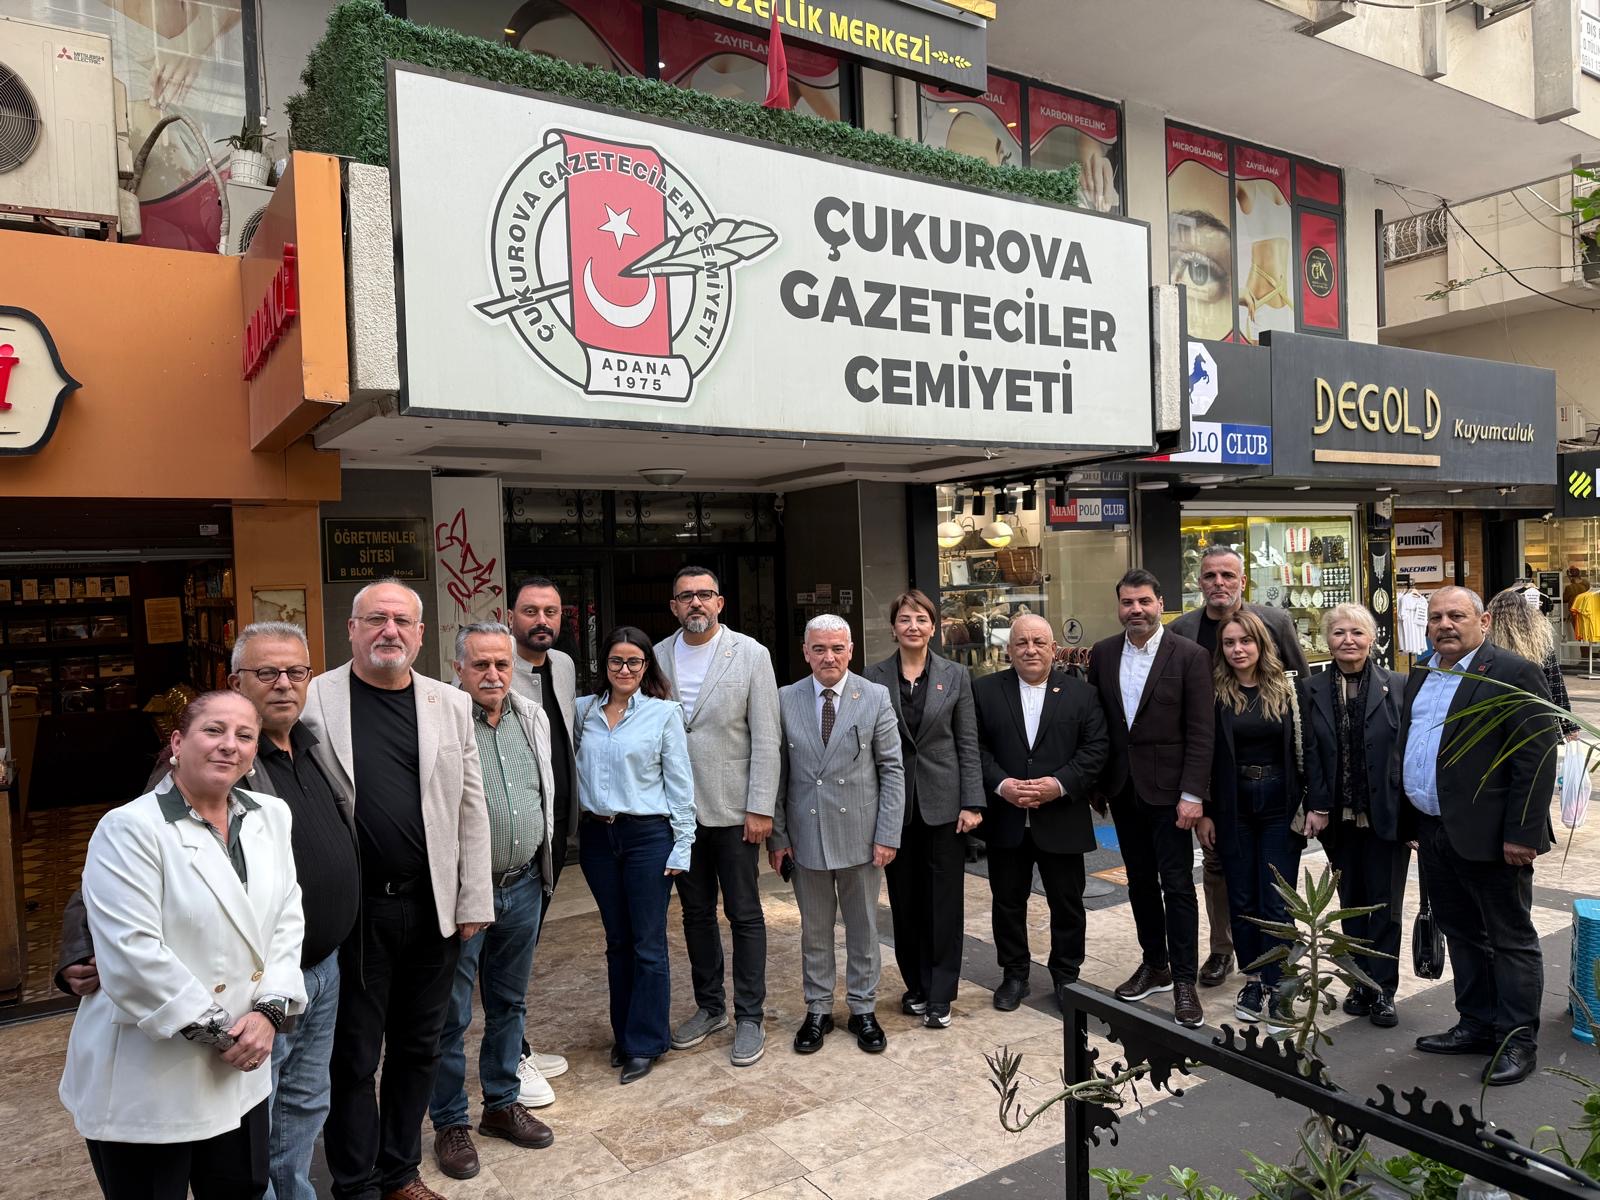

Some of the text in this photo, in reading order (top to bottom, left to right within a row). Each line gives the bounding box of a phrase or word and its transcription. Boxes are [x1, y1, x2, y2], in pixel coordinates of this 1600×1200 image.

[829, 11, 931, 65] MERKEZİ
[1040, 106, 1106, 131] KARBON PEELING
[1172, 140, 1223, 161] MICROBLADING
[1245, 160, 1279, 177] ZAYIFLAMA
[813, 195, 1093, 285] ÇUKUROVA
[507, 150, 725, 351] ÇUKUROVA GAZETECİLER CEMİYETİ
[779, 269, 1118, 353] GAZETECİLER
[601, 357, 672, 377] ADANA
[613, 374, 663, 392] 1975
[844, 349, 1074, 415] CEMİYETİ
[1312, 376, 1535, 445] DEGOLD Kuyumculuk
[1226, 432, 1268, 456] CLUB
[1051, 503, 1125, 518] MIAMI POLO CLUB
[334, 528, 417, 545] ÖĞRETMENLER
[1397, 534, 1431, 547] PUMA
[359, 546, 396, 564] SİTESİ
[340, 567, 347, 577] B
[350, 567, 375, 577] BLOK
[1400, 564, 1438, 574] SKECHERS
